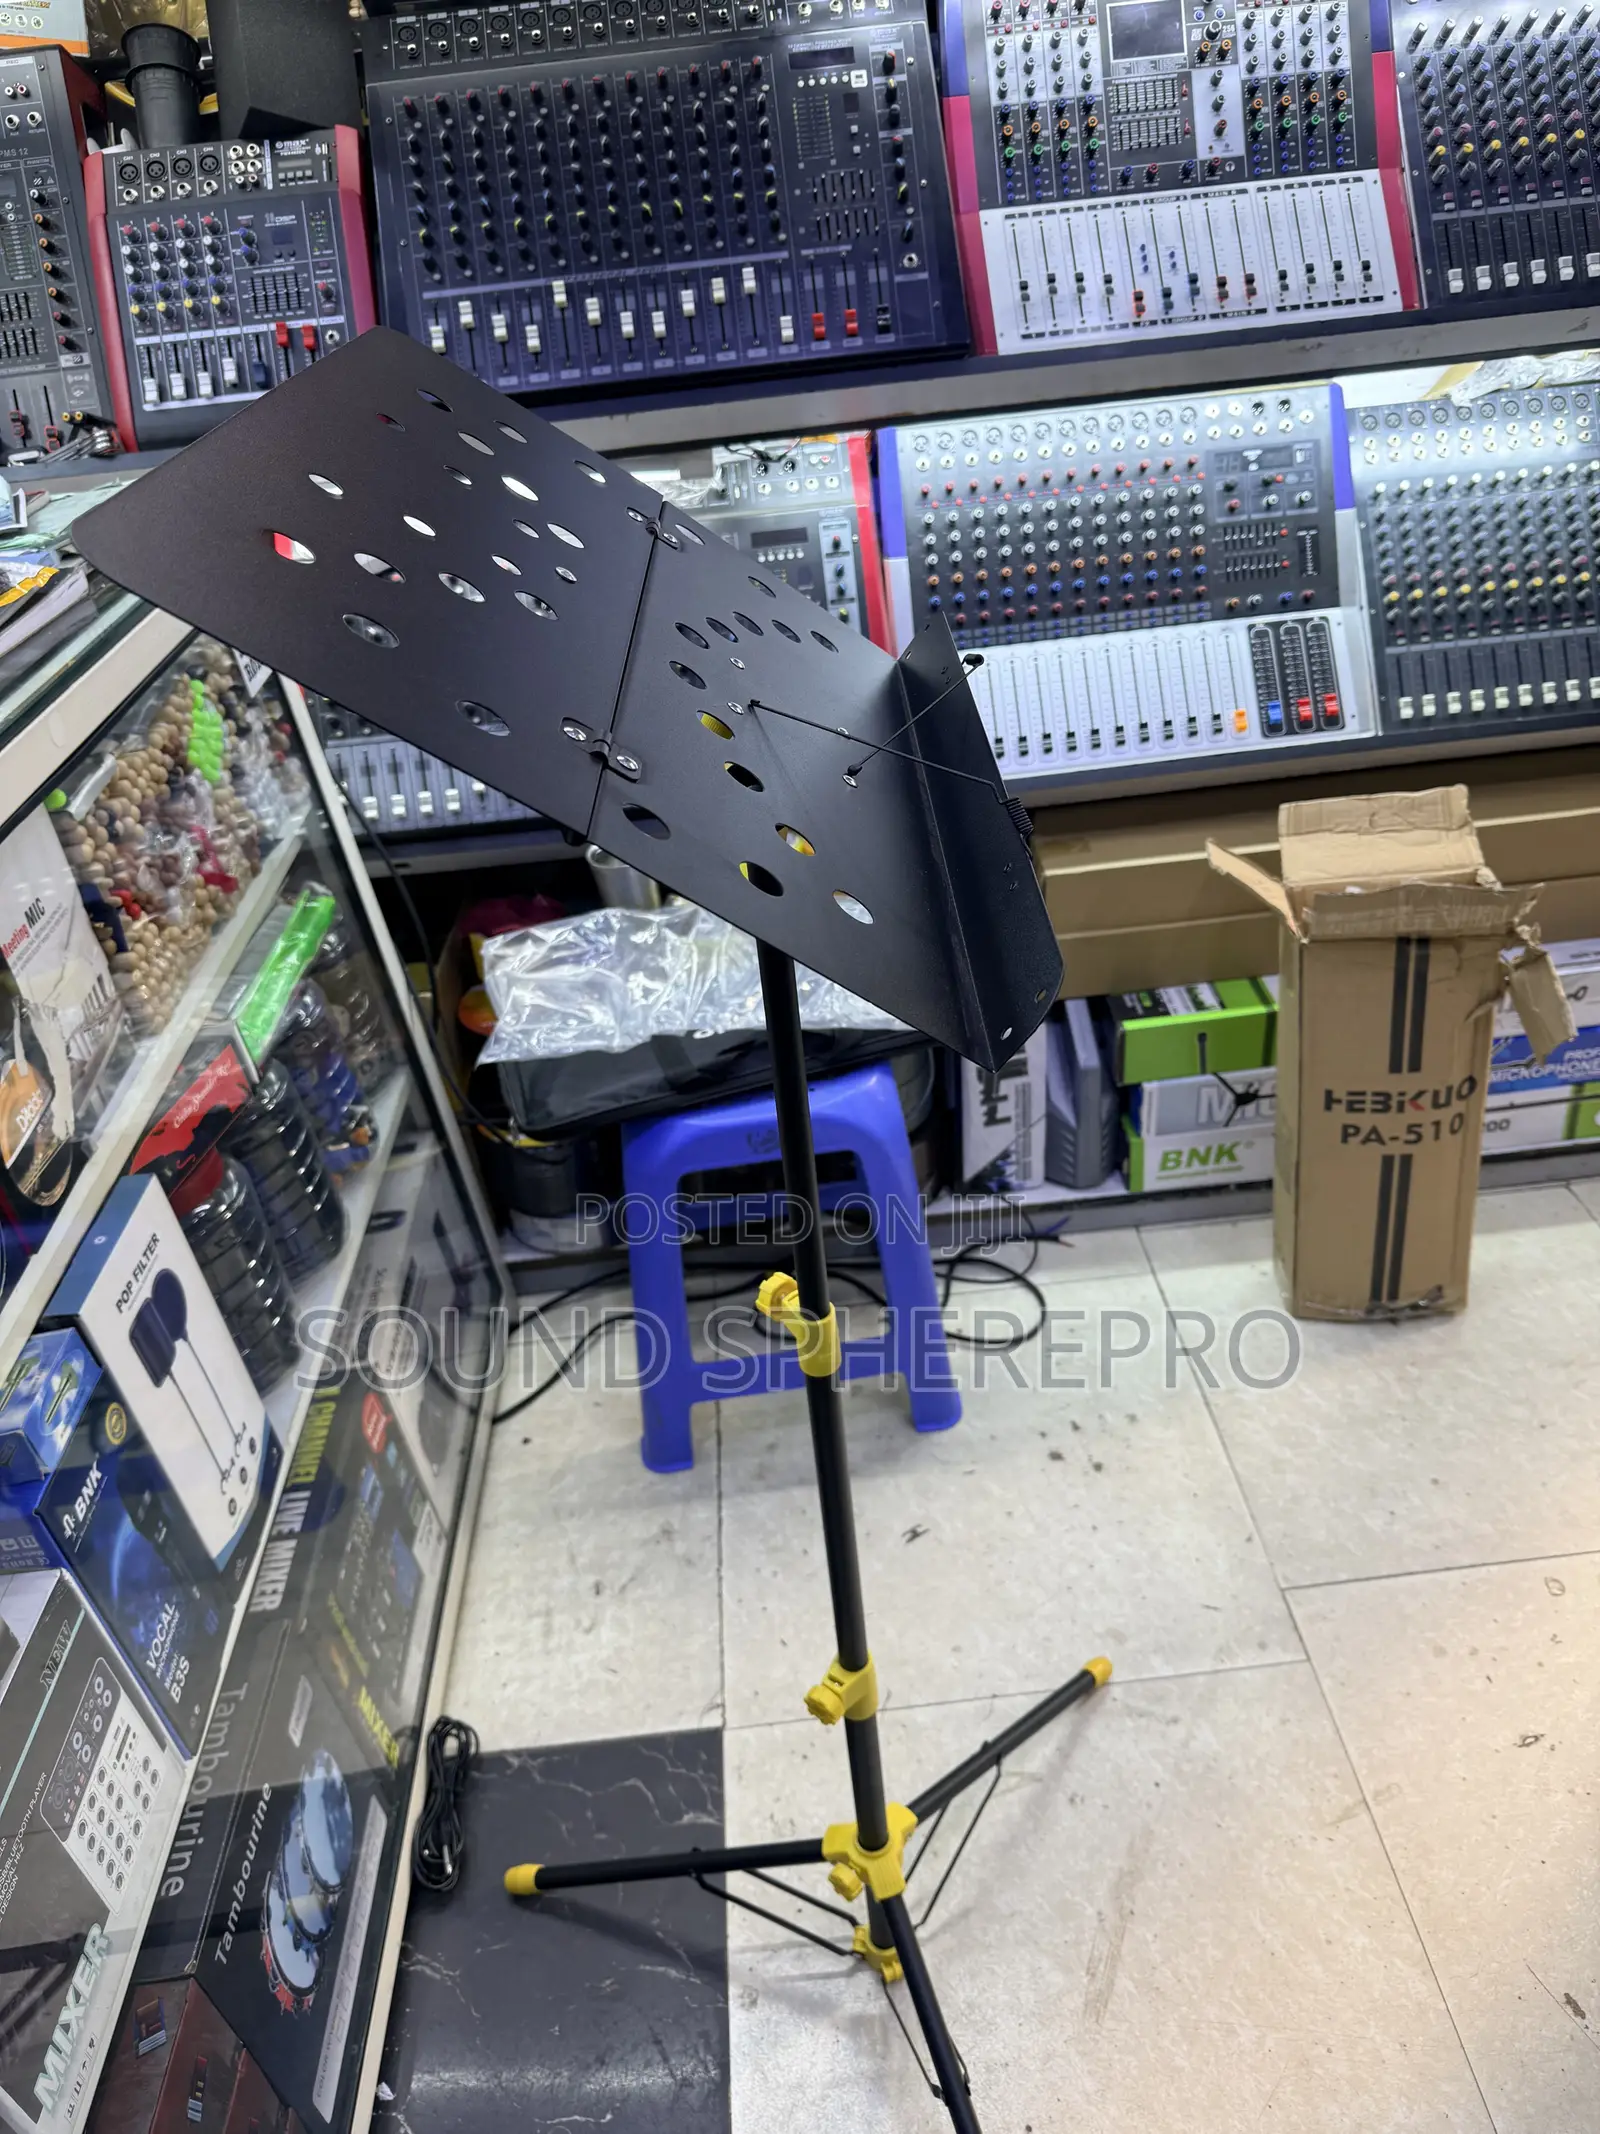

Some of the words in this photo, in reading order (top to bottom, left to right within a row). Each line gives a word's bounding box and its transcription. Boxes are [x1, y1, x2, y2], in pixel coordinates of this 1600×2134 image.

[24, 897, 46, 929] MIC
[1159, 1141, 1242, 1171] BNK
[1341, 1112, 1465, 1147] PA-510
[115, 1280, 134, 1314] POP
[132, 1232, 161, 1283] FILTER
[74, 1459, 103, 1523] BNK
[146, 1602, 176, 1670] VOCAL
[170, 1655, 191, 1704] B3S
[159, 1682, 249, 1897] Tambourine
[0, 1811, 33, 1891] SB/BLUETOOTH
[29, 1771, 47, 1812] PLAYER
[1, 1875, 19, 1915] DESIGN
[214, 1782, 272, 1966] Tambourine
[33, 1921, 110, 2112] MIXER
